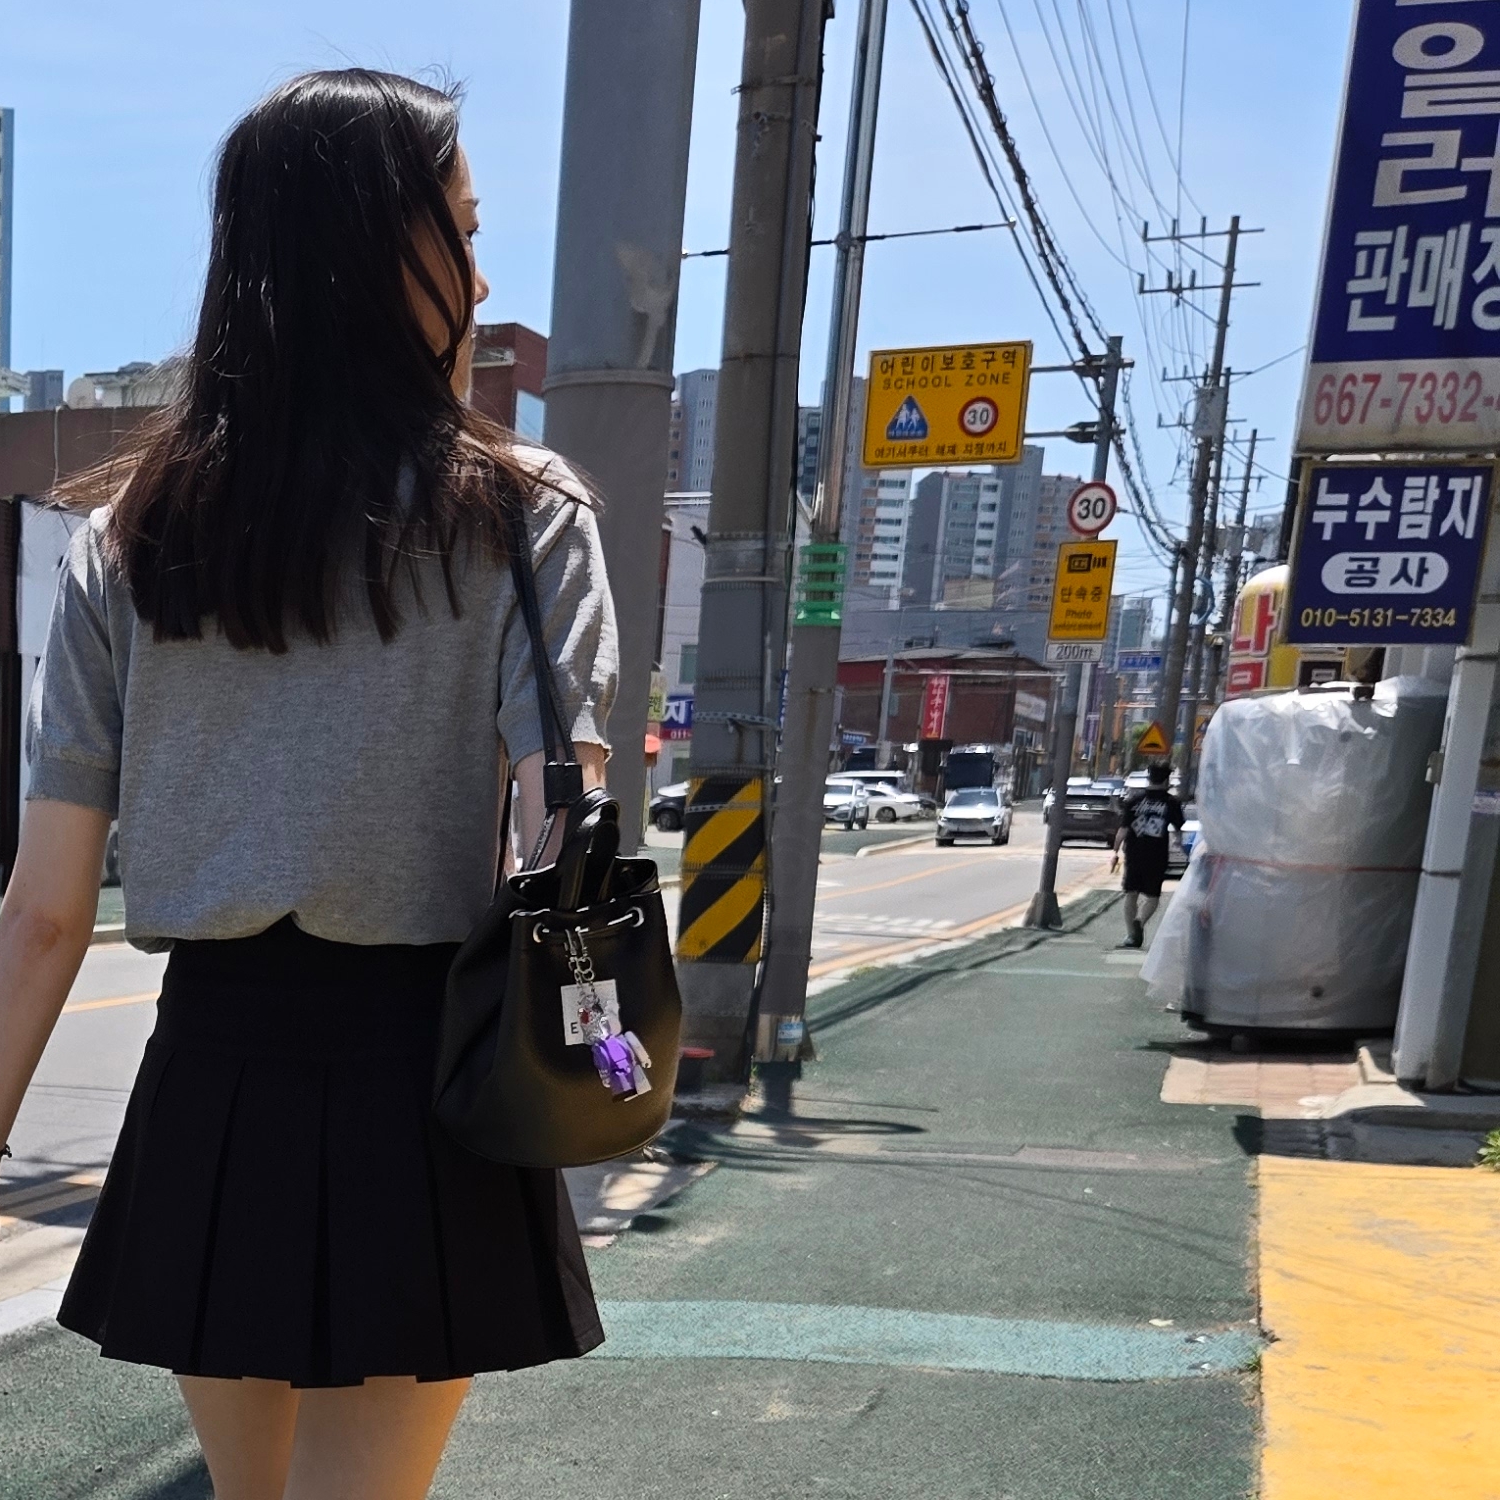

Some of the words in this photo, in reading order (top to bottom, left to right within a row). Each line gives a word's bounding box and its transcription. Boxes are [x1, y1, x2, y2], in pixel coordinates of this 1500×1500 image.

[880, 349, 1016, 377] 어린이보호구역
[882, 375, 952, 391] SCHOOL
[964, 371, 1011, 387] ZONE
[967, 408, 990, 426] 30
[1077, 497, 1107, 520] 30
[1311, 475, 1483, 541] 누수탐지
[1344, 556, 1429, 588] 공사
[1301, 607, 1456, 628] 010-5131-7334
[1055, 645, 1094, 661] 200m
